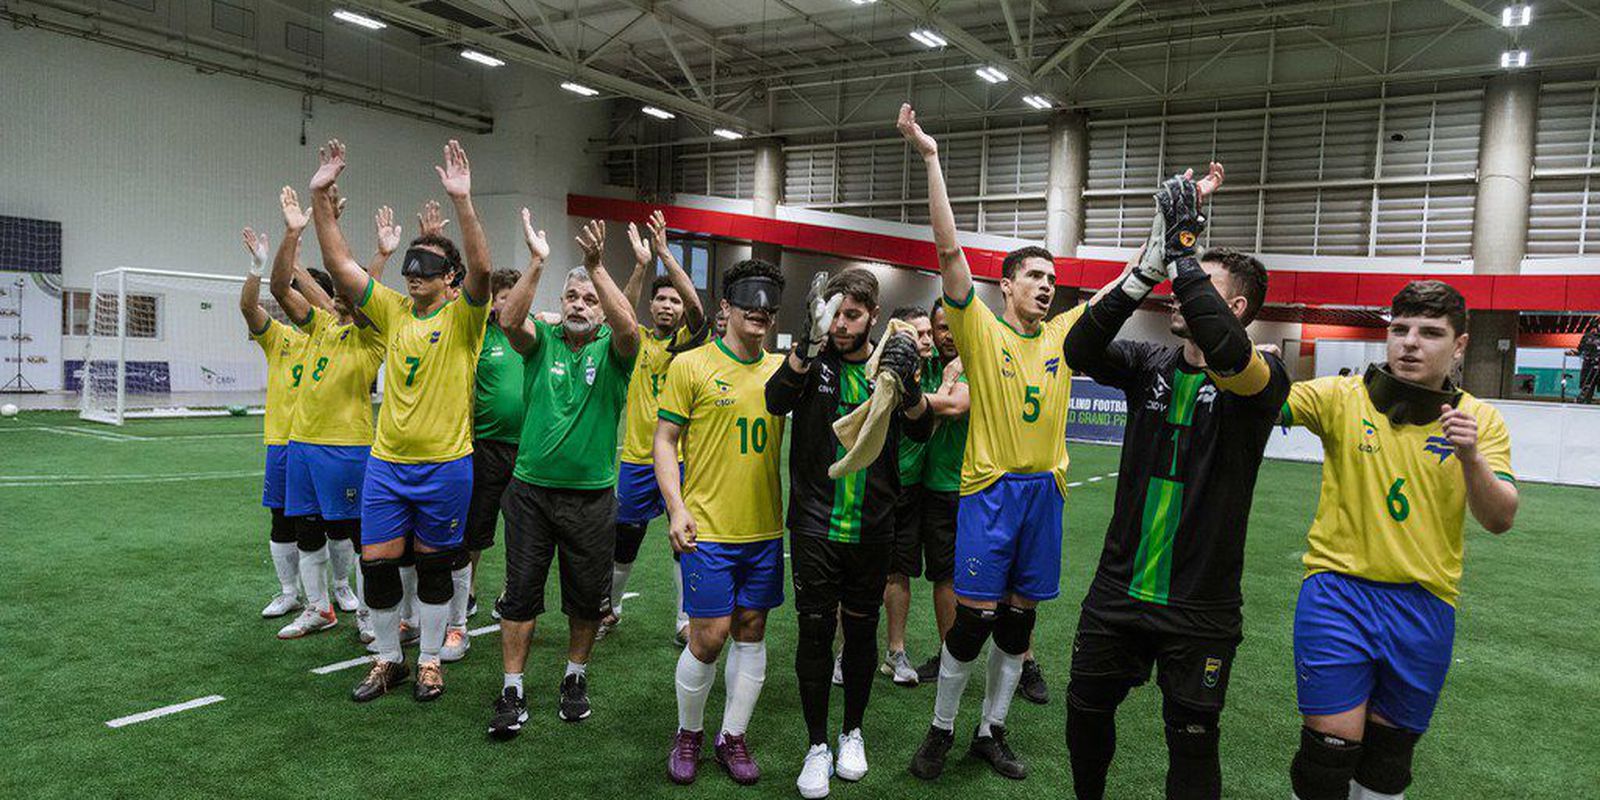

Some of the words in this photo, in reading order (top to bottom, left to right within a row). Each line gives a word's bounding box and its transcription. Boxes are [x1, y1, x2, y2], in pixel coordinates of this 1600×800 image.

[292, 364, 303, 387] 9
[312, 356, 328, 382] 8
[405, 356, 420, 387] 7
[1022, 385, 1041, 423] 5
[1078, 411, 1111, 426] GRAND
[735, 416, 768, 455] 10
[1169, 429, 1181, 476] 1
[1386, 477, 1410, 522] 6
